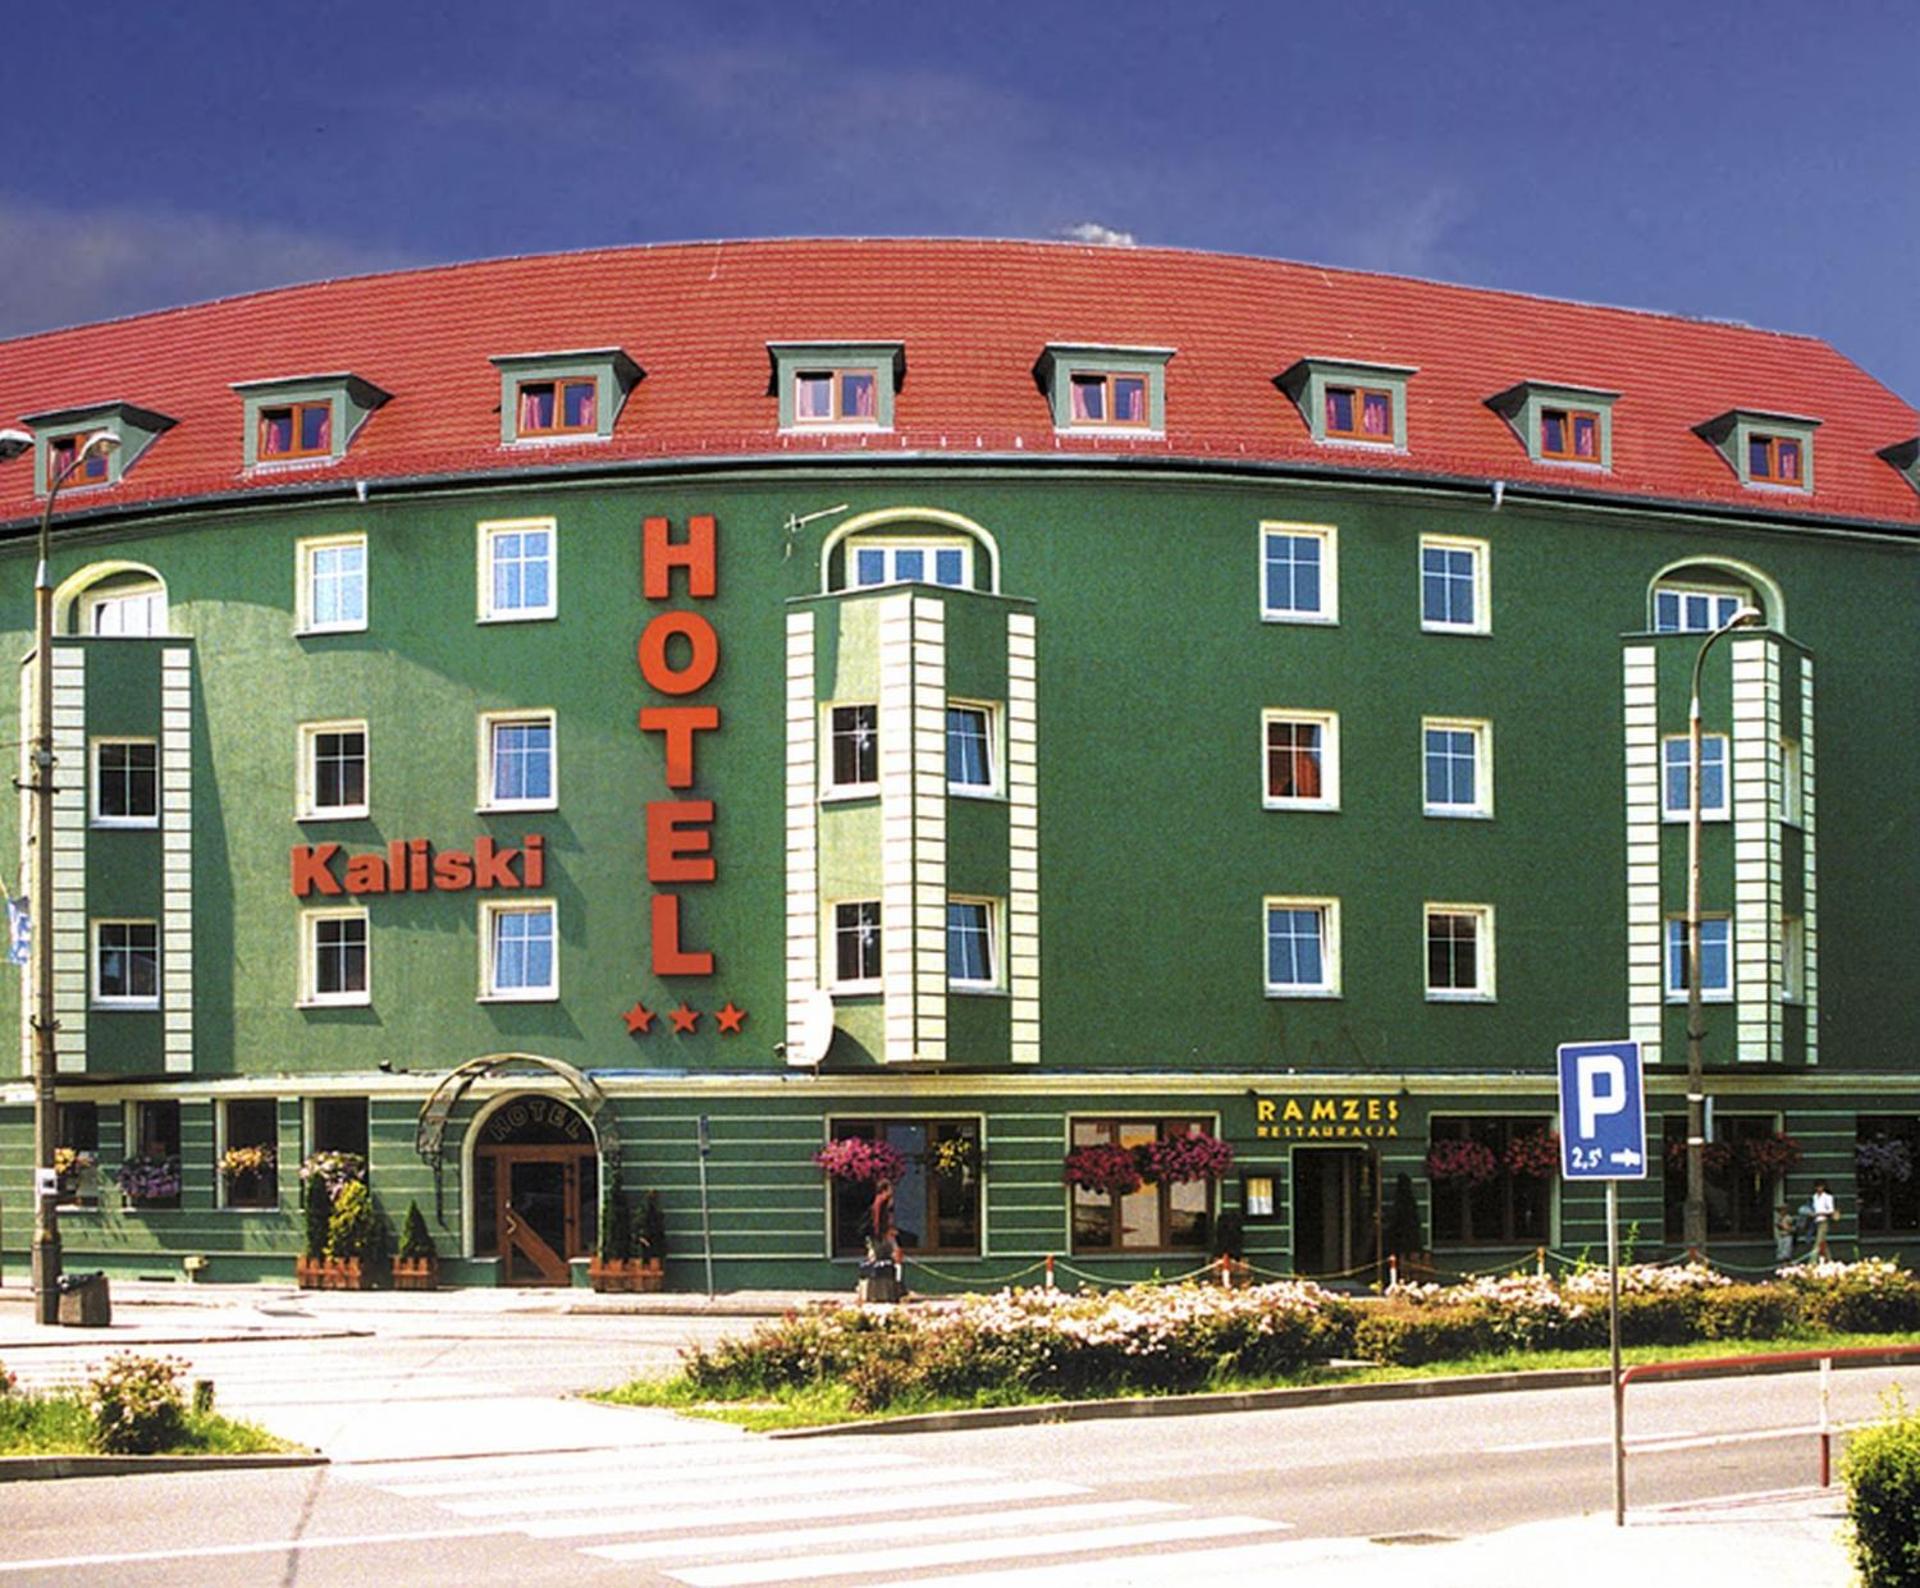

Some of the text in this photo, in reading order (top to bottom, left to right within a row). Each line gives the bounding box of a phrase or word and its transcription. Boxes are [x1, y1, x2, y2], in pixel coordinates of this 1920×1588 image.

[638, 515, 720, 977] HOTEL
[291, 834, 545, 897] Kaliski
[489, 1101, 581, 1142] HOTEL
[1256, 1099, 1399, 1121] RAMZES
[1577, 1053, 1627, 1140] P
[1256, 1126, 1399, 1137] RESTAURACJA
